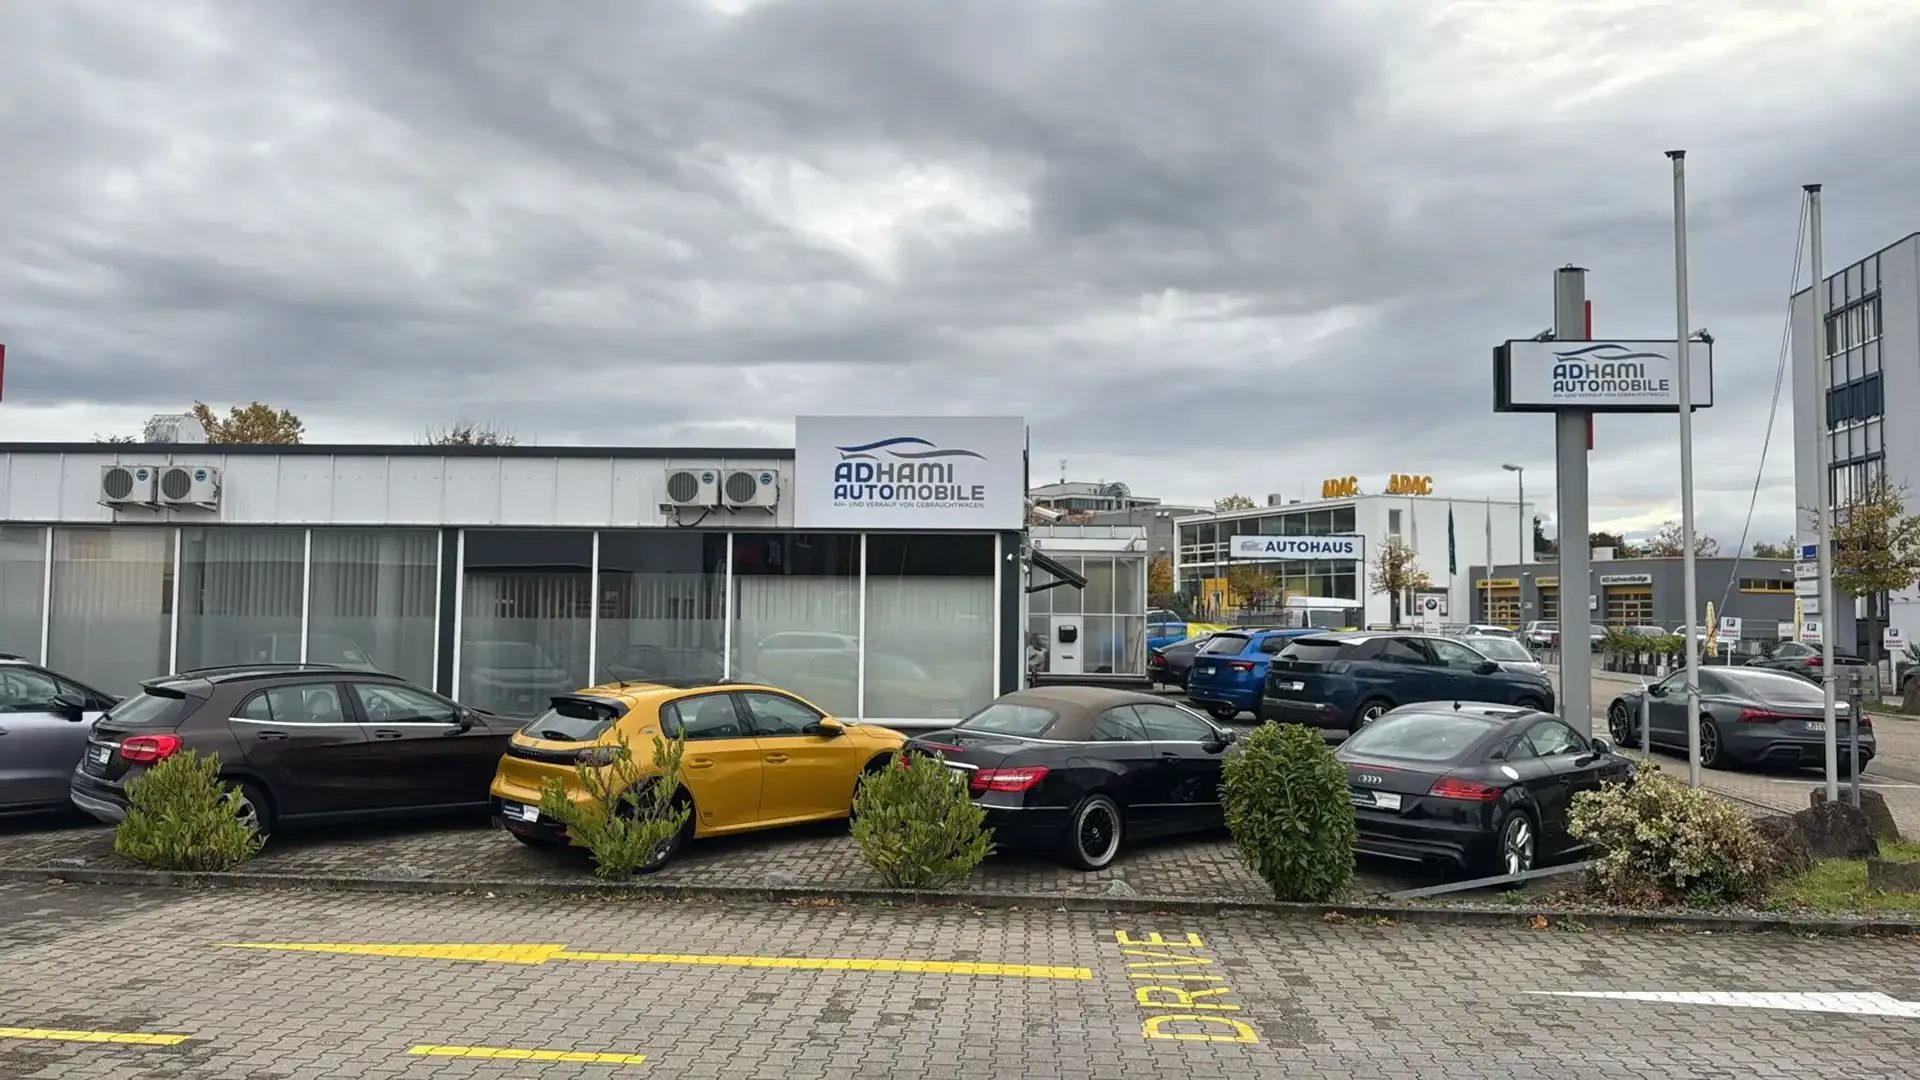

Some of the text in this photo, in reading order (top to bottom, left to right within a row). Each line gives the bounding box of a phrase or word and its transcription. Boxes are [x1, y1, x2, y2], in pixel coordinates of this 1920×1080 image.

[1553, 363, 1644, 379] ADHAMI
[1553, 379, 1670, 392] AUTOMOBILE
[834, 462, 953, 483] ADHAMI
[834, 484, 985, 500] AUTOMOBILE
[1322, 476, 1358, 498] ADAC
[1388, 474, 1434, 496] ADAC
[1265, 540, 1354, 553] AUTOHAUS
[1115, 930, 1260, 1044] DRIVE
